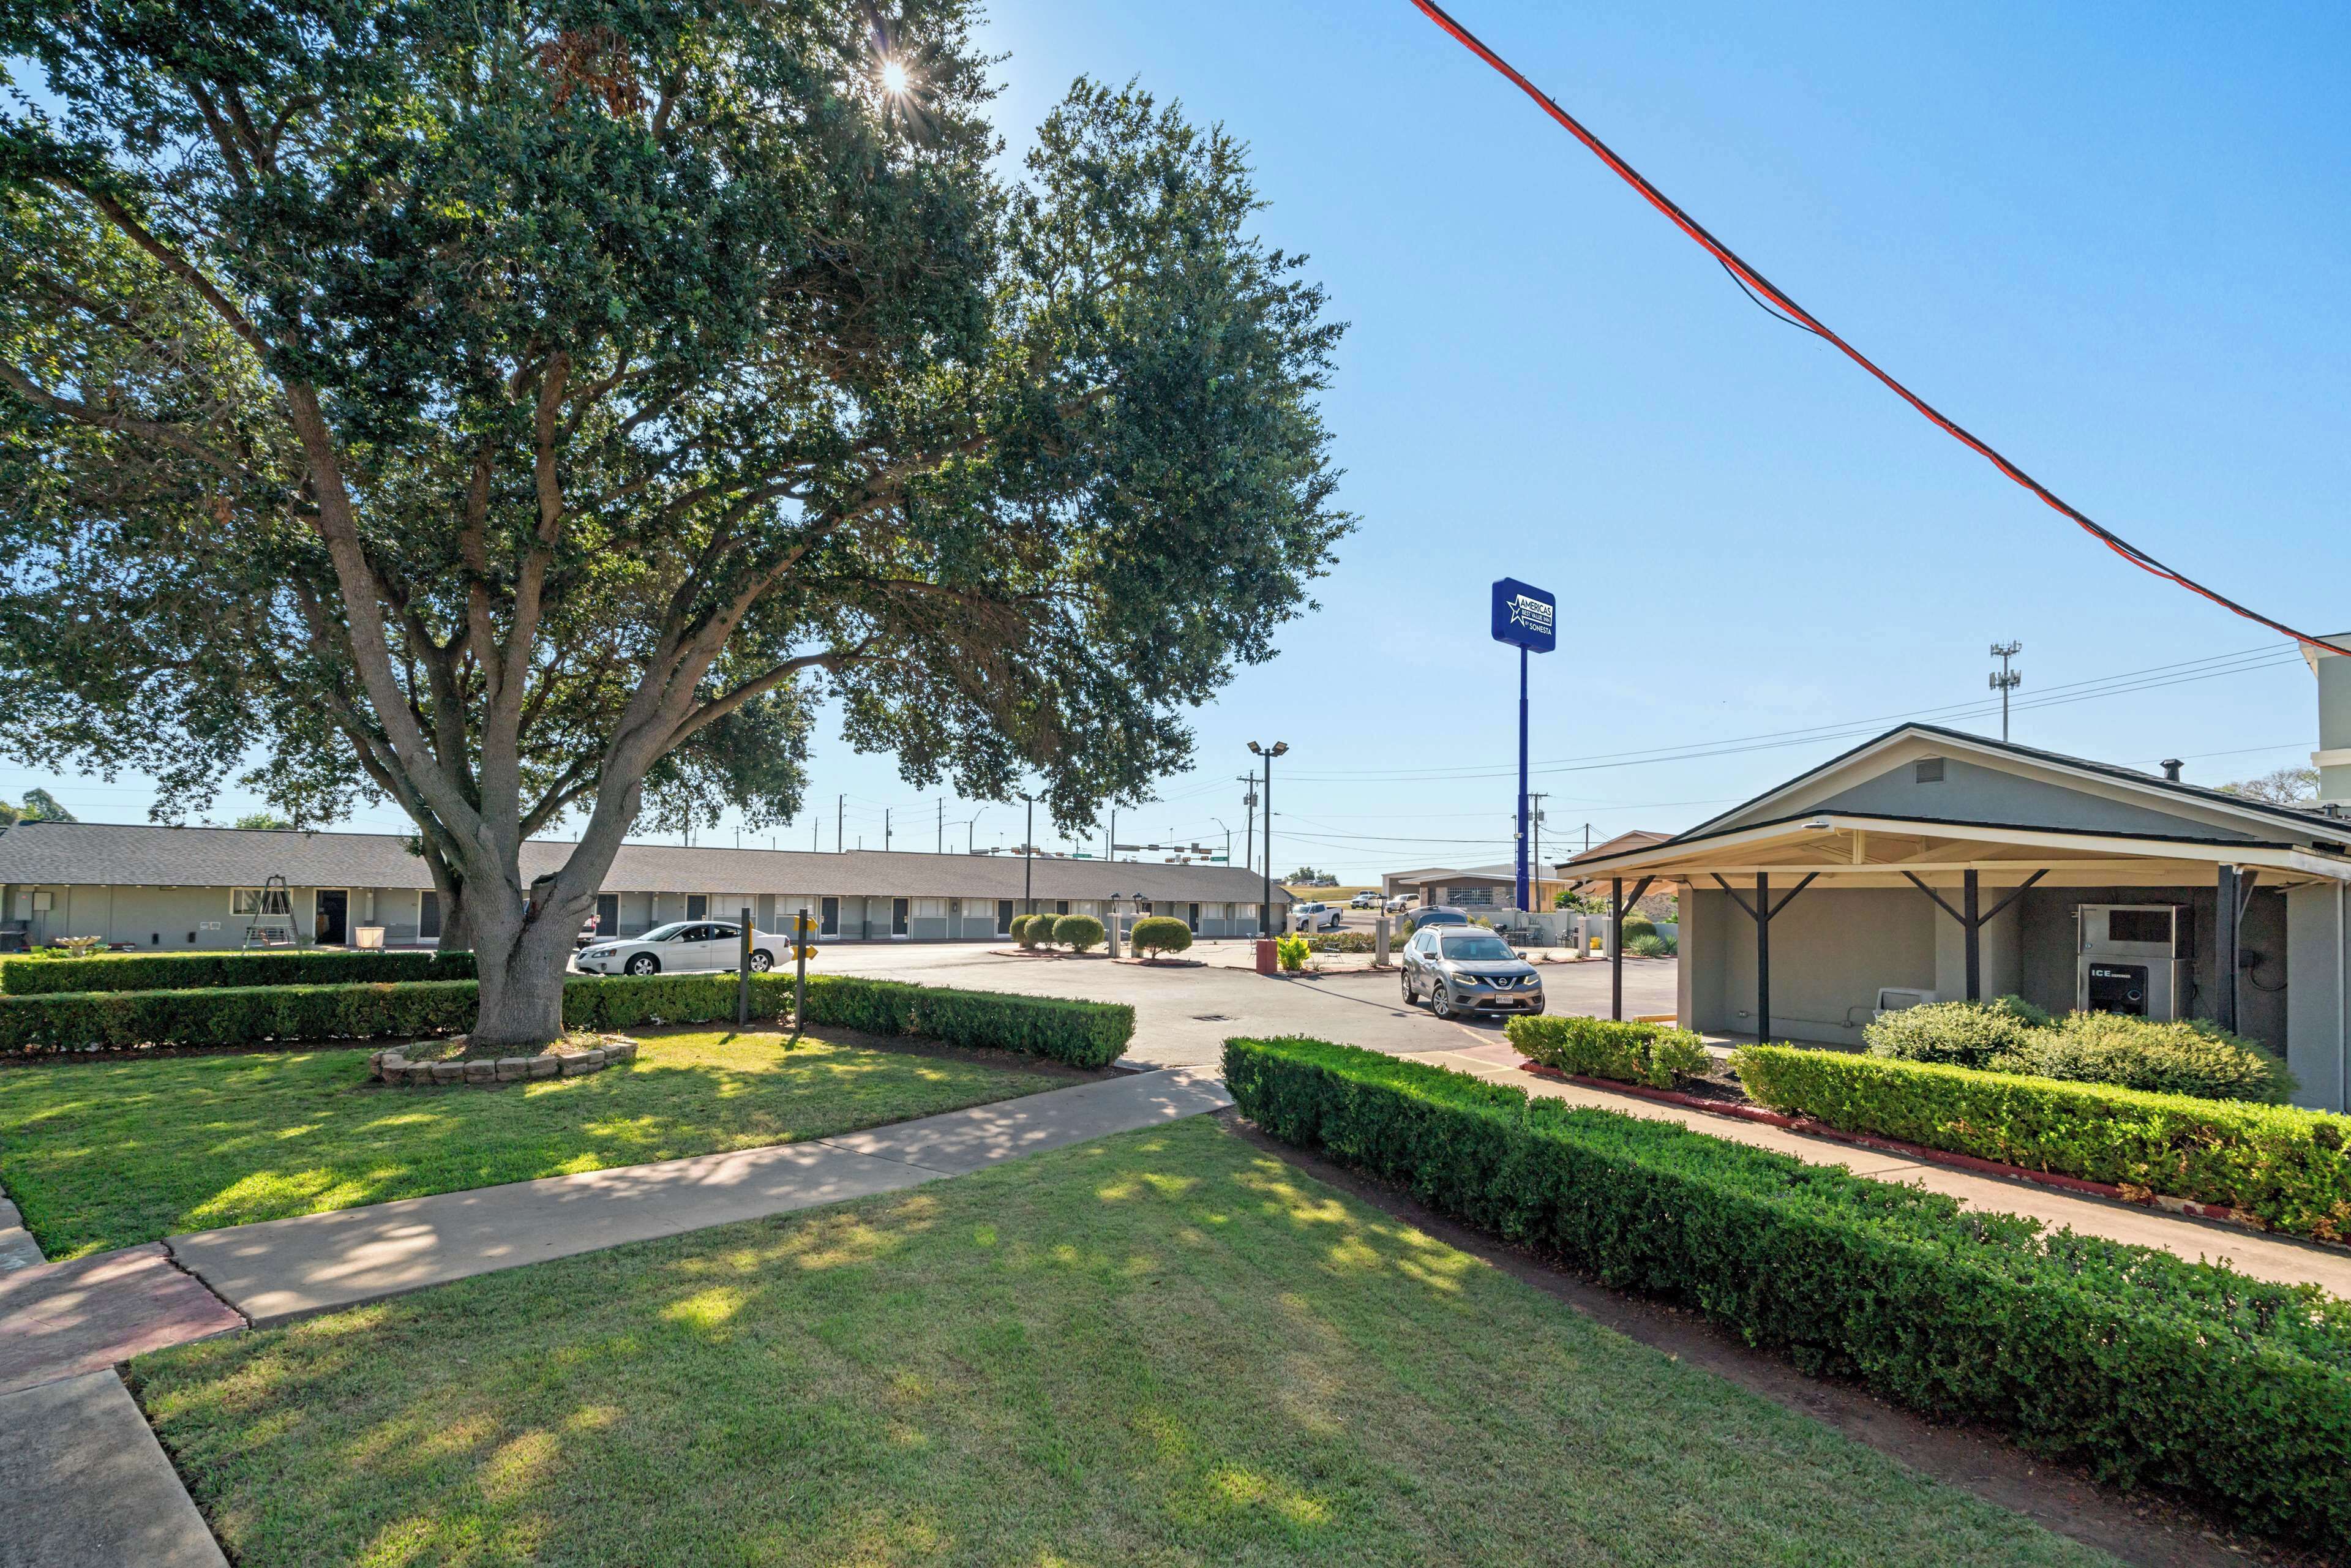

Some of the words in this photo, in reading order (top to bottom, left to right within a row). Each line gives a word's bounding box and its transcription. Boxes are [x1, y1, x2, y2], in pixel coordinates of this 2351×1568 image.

[1521, 599, 1551, 615] AMERICAS
[1531, 612, 1542, 621] VALUE
[1529, 623, 1551, 635] SONESTA
